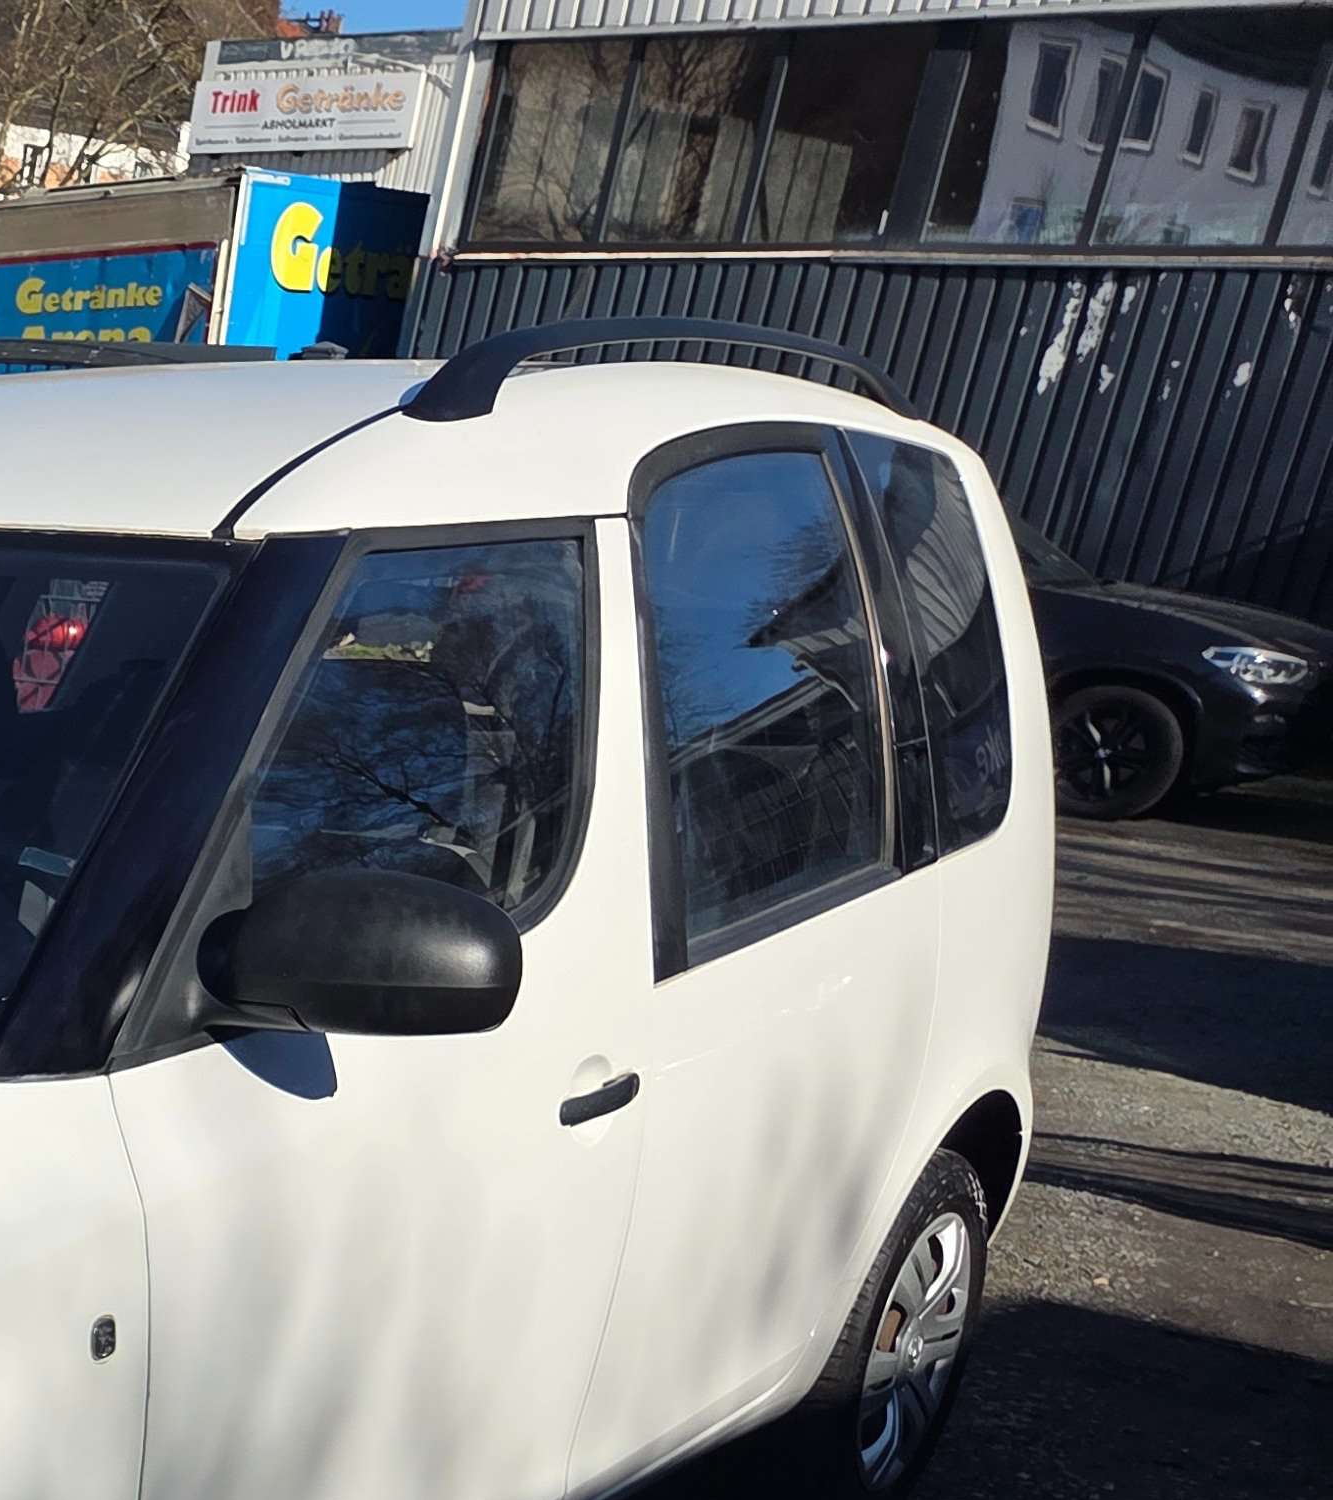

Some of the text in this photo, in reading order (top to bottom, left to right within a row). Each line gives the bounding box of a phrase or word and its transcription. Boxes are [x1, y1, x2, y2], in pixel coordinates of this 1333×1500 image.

[211, 83, 406, 115] Trink Getränke
[261, 118, 336, 130] ABHOLMARKT
[15, 276, 163, 315] Getränke
